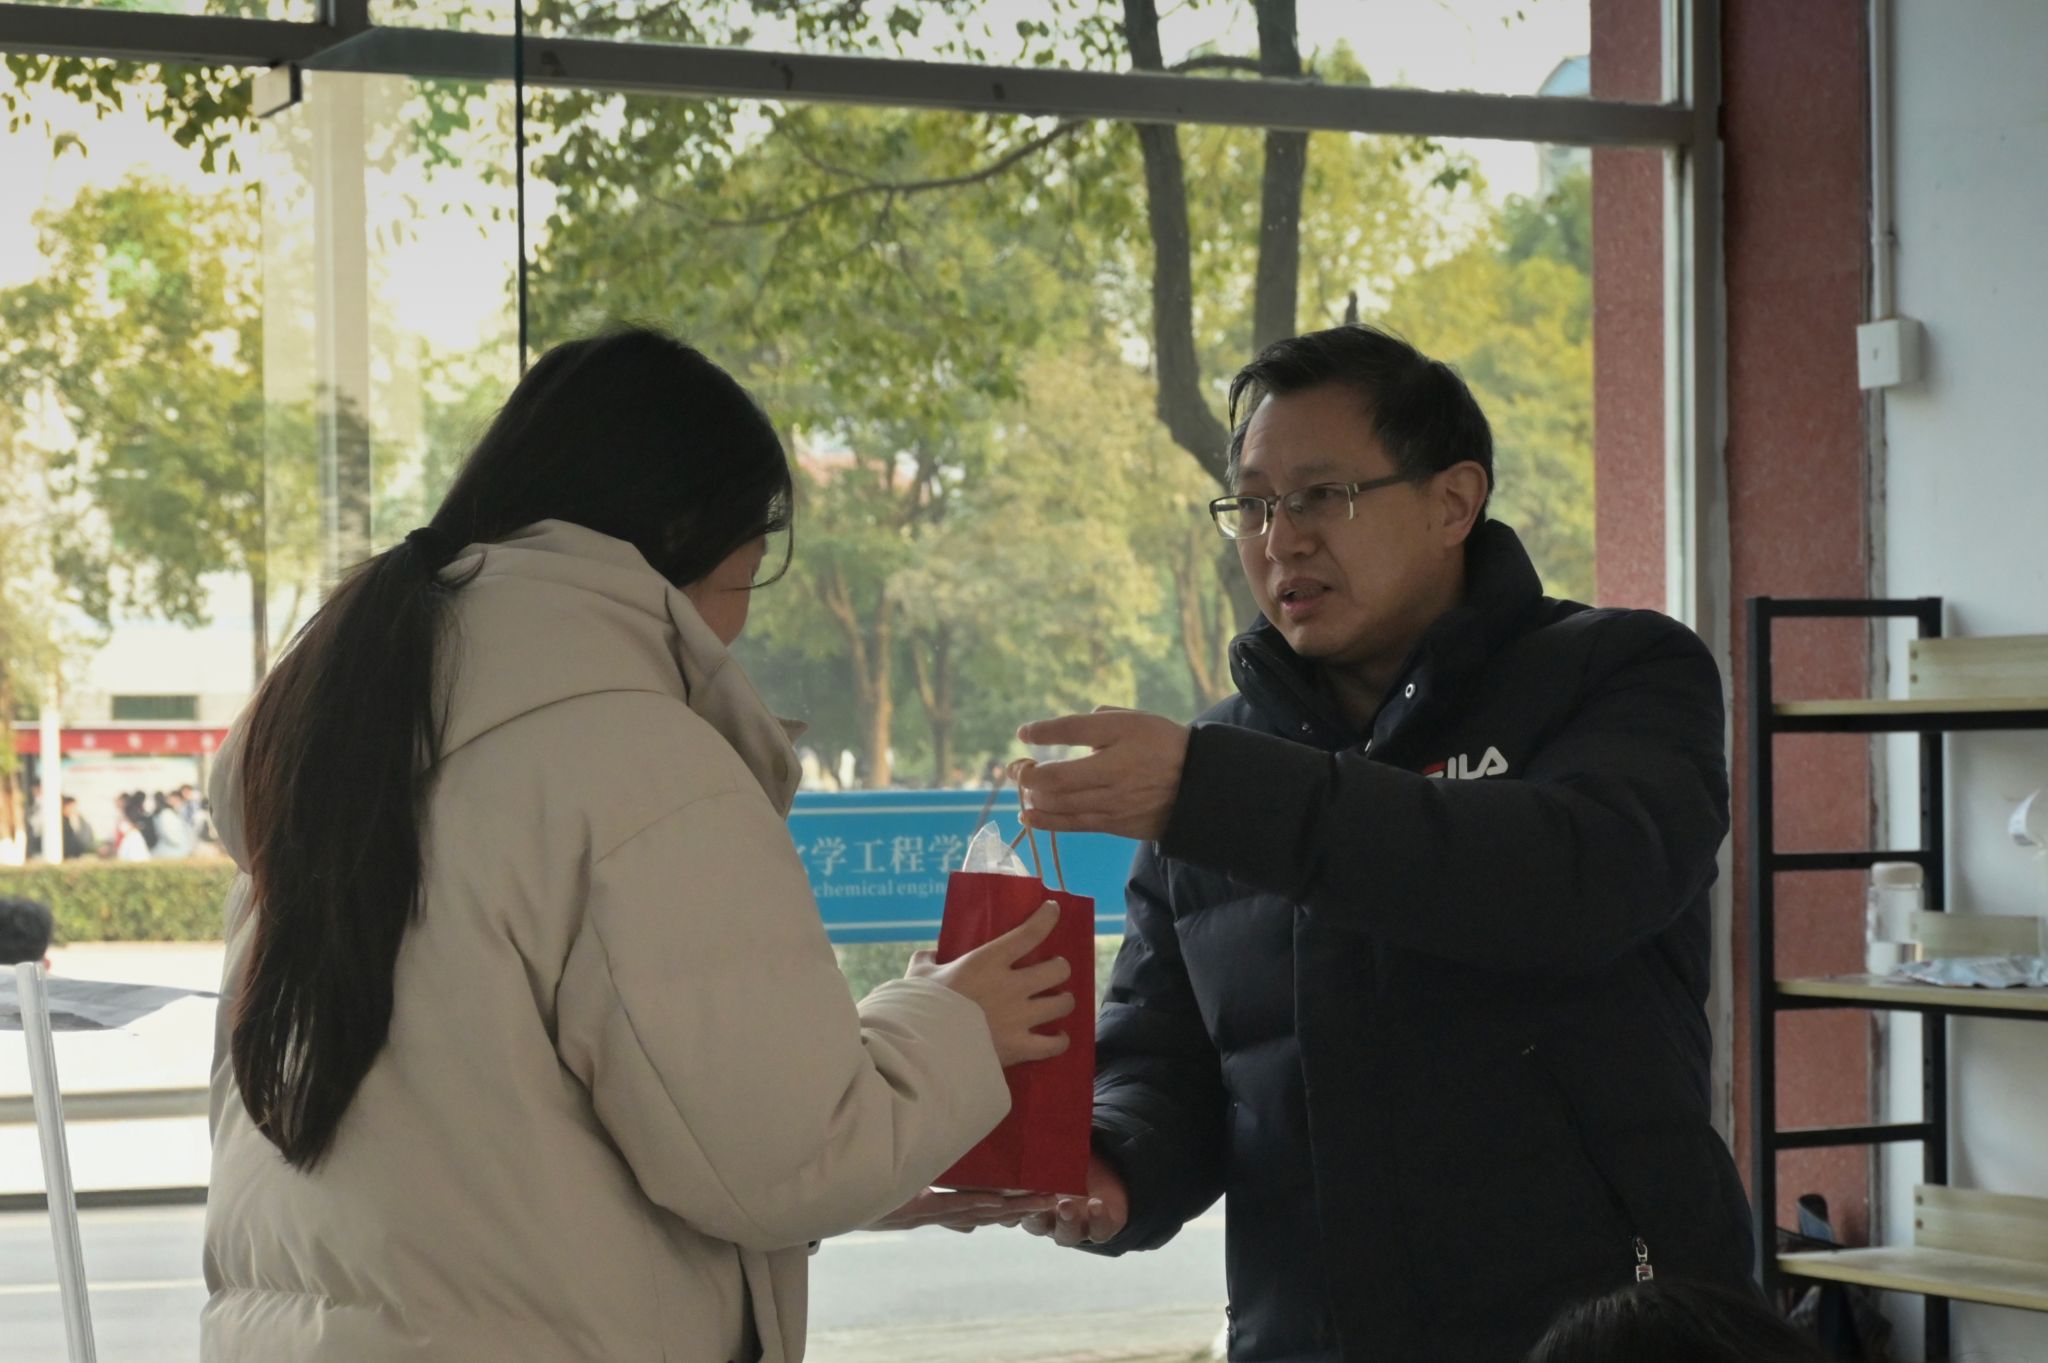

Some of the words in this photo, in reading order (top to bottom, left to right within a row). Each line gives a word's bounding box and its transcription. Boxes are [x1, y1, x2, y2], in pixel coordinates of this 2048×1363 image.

[796, 834, 973, 877] 学工程学
[813, 879, 893, 897] chemical
